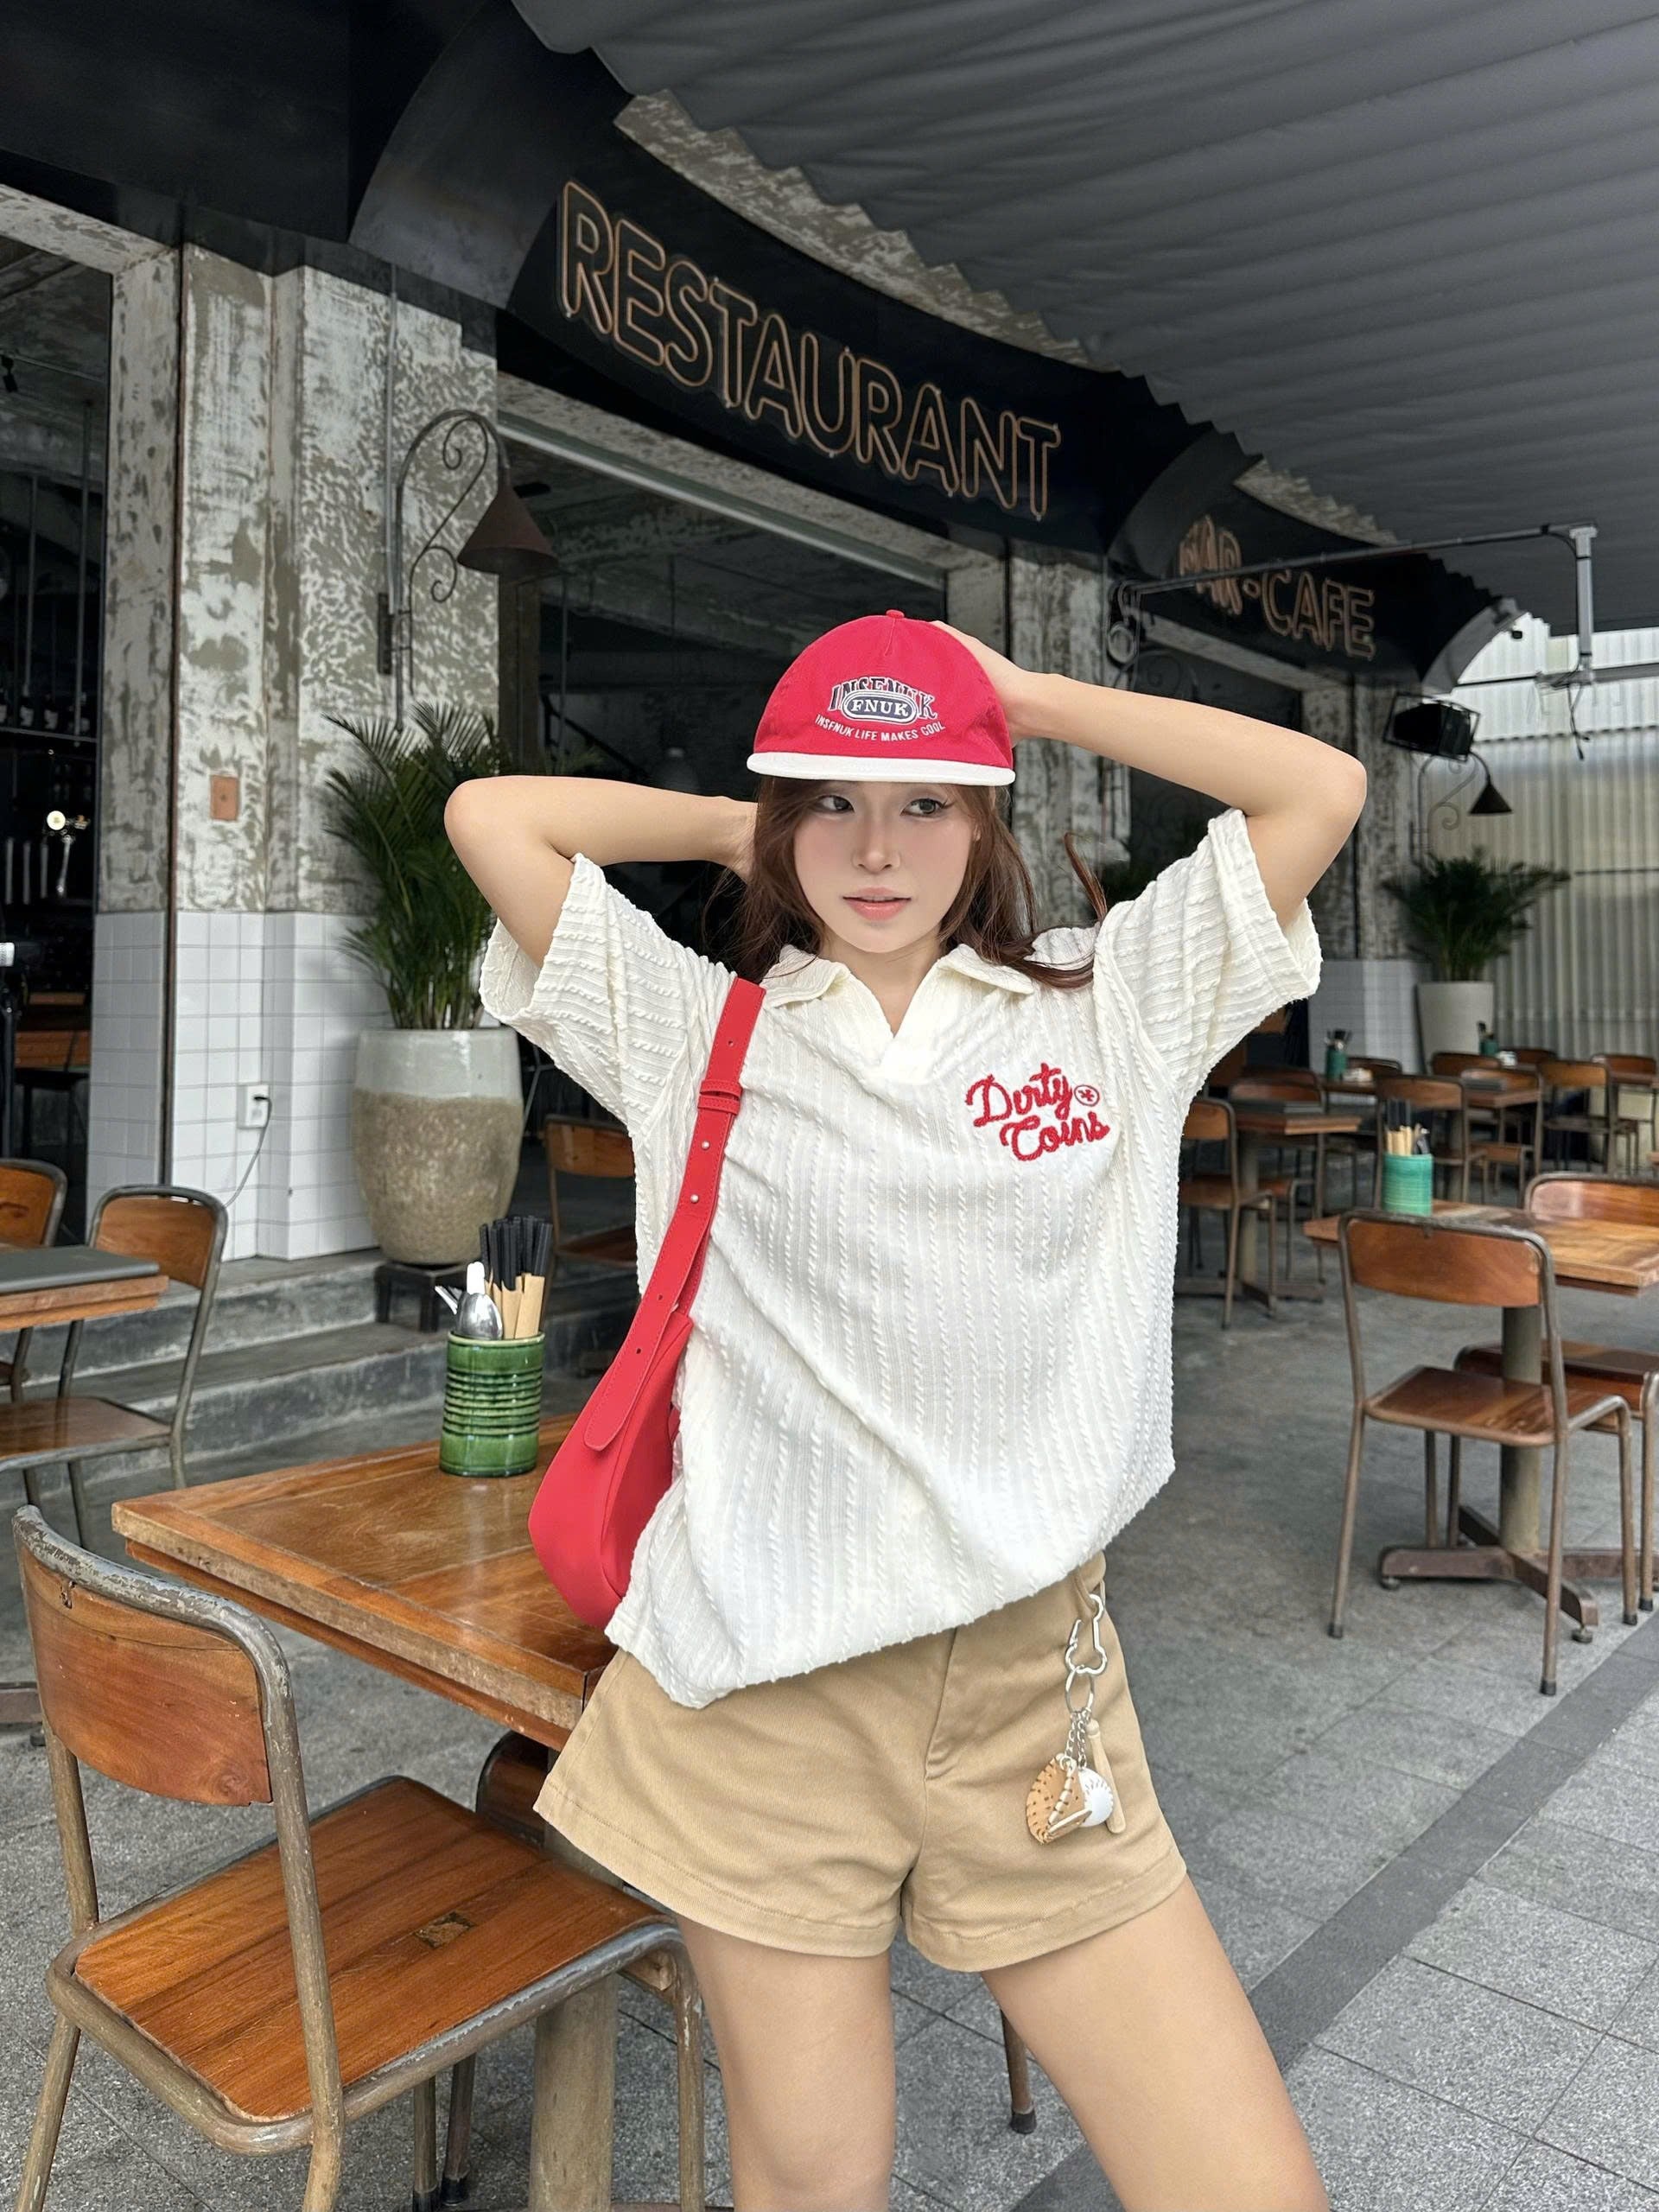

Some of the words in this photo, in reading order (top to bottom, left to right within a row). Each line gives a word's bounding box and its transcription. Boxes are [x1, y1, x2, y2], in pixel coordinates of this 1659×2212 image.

[560, 179, 1061, 521] RESTAURANT
[1262, 567, 1376, 661] CAFE
[850, 698, 910, 718] FNUK
[855, 728, 879, 741] LIFE
[880, 728, 919, 742] MAKES
[920, 721, 947, 736] COOL
[999, 1110, 1111, 1162] Coins
